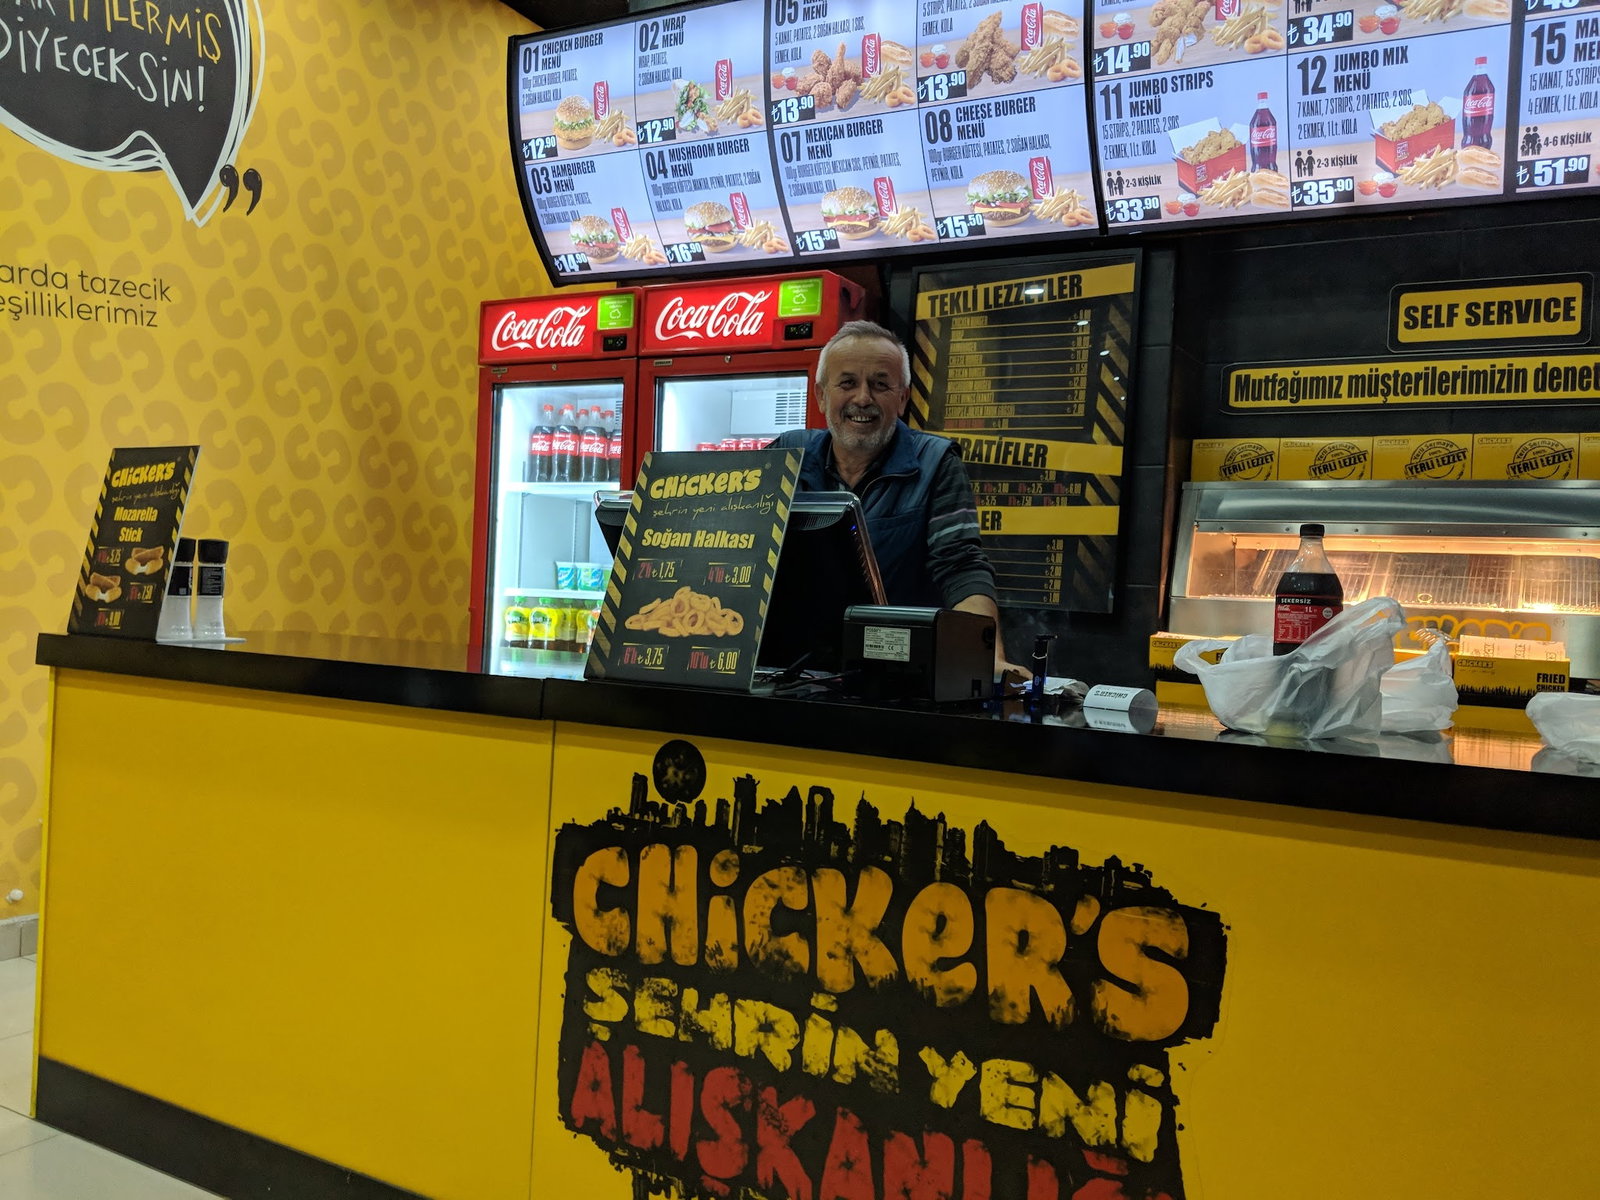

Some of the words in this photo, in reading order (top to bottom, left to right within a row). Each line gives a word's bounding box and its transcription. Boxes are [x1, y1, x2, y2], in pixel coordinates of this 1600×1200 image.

[775, 0, 798, 26] 05
[803, 2, 827, 21] MENÜ
[639, 21, 659, 52] 02
[663, 16, 686, 32] WRAP
[662, 30, 684, 48] MENÜ
[1531, 21, 1566, 66] 15
[523, 46, 539, 73] 01
[542, 39, 573, 56] CHICKEN
[574, 33, 603, 49] BURGER
[542, 54, 561, 71] MENÜ
[1297, 55, 1327, 96] 12
[1334, 50, 1379, 72] JUMBO
[1383, 46, 1408, 66] MIX
[1334, 70, 1370, 93] MENÜ
[1100, 83, 1122, 121] 11
[1129, 77, 1168, 98] JUMBO
[1171, 71, 1213, 92] STRIPS
[1130, 96, 1161, 117] MENÜ
[926, 109, 952, 144] 08
[956, 103, 993, 123] CHEESE
[995, 97, 1036, 117] BURGER
[957, 120, 985, 141] MENÜ
[780, 131, 801, 163] 07
[806, 122, 845, 143] MEXICAN
[847, 119, 883, 138] BURGER
[807, 142, 832, 160] MENÜ
[1544, 137, 1558, 147] 4-6
[1560, 132, 1592, 146] KİŞİLİK
[645, 151, 668, 180] 04
[669, 143, 715, 162] MUSHROOM
[717, 138, 750, 155] BURGER
[671, 160, 693, 178] MENÜ
[1317, 159, 1329, 168] 2-3
[1331, 155, 1357, 168] KİŞİLİK
[531, 166, 552, 194] 03
[551, 161, 596, 178] HAMBURGER
[554, 178, 575, 192] MENÜ
[1126, 178, 1137, 187] 2-3
[1138, 175, 1162, 187] KİŞİLİK
[78, 270, 171, 302] tazecik
[928, 285, 978, 318] TEKLİ
[984, 274, 1082, 310] LEZZETLER
[654, 290, 772, 341] Coca-Cola
[1404, 302, 1460, 331] SELF
[1465, 296, 1577, 326] SERVICE
[492, 306, 592, 352] Coca-Cola
[1234, 370, 1343, 404] Mutfağımız
[1347, 363, 1527, 404] müşterilerimizin
[951, 435, 1048, 468] RATİFLER
[1436, 451, 1467, 466] LEZZET
[1540, 451, 1573, 467] LEZZET
[114, 506, 158, 521] Mozarella
[693, 504, 716, 520] yeni
[119, 527, 143, 542] Stick
[642, 528, 692, 549] Soğan
[693, 530, 755, 549] Halkası
[1537, 673, 1565, 684] FRIED
[582, 967, 900, 1094] ŞEHRİN
[919, 1046, 1165, 1164] YENİ
